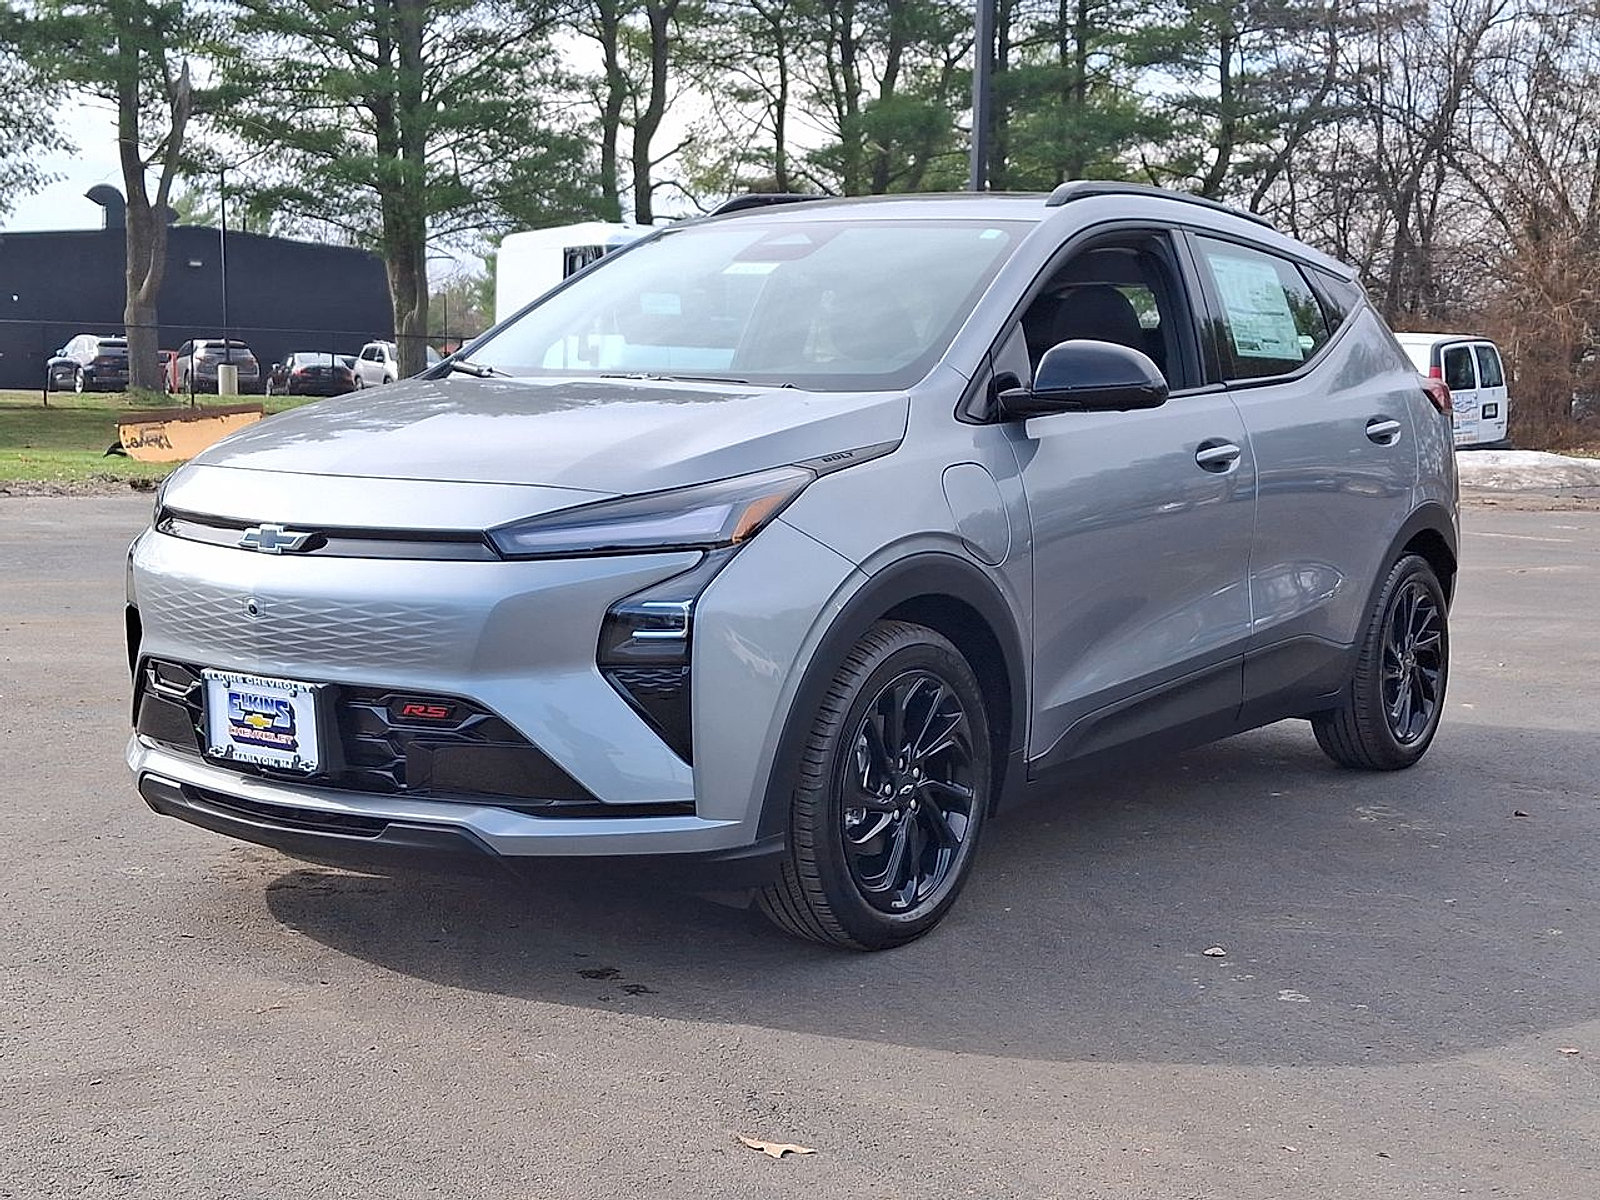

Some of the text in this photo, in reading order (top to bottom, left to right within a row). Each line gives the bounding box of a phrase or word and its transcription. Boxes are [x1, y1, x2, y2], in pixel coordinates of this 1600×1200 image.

[245, 677, 311, 693] CHEVROLET
[227, 691, 292, 728] ELKINS
[403, 704, 448, 718] RS
